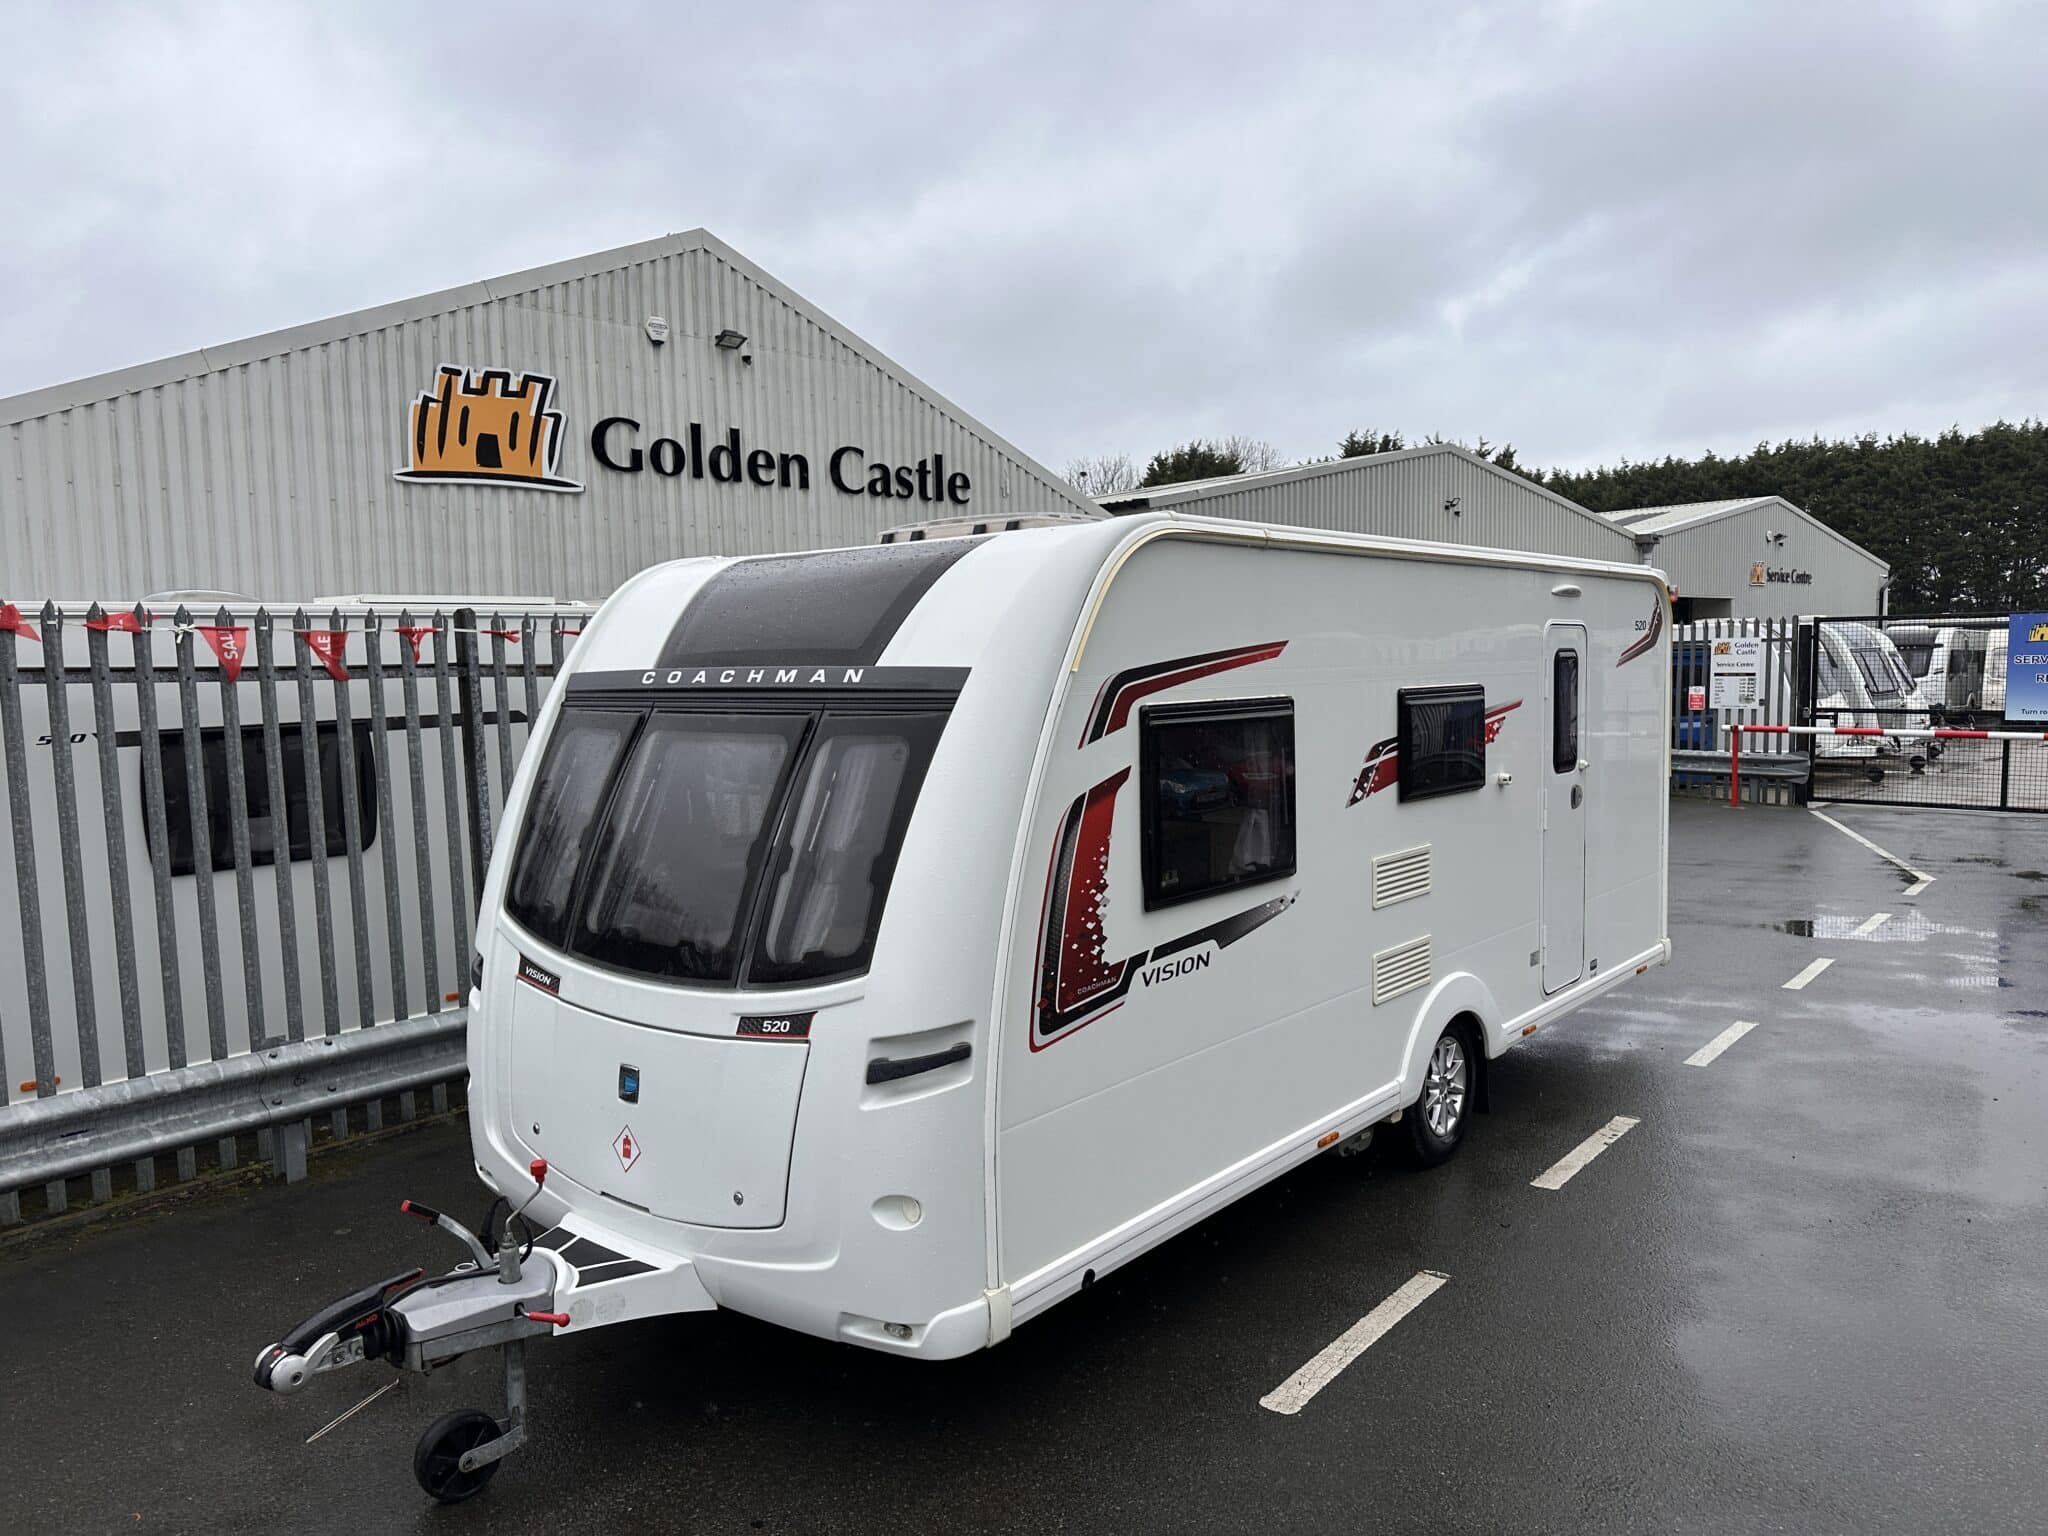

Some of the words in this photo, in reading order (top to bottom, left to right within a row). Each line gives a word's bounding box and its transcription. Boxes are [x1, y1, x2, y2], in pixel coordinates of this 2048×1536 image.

[591, 416, 809, 490] Golden
[830, 446, 971, 504] Castle
[1766, 567, 1790, 583] Service
[1791, 569, 1812, 585] Centre
[1635, 620, 1647, 631] 520
[218, 630, 239, 660] SAL
[1734, 641, 1759, 649] Golden
[1736, 648, 1757, 656] Castle
[642, 668, 864, 685] COACHMAN
[36, 733, 87, 746] 50
[525, 965, 552, 985] VISION
[1142, 951, 1210, 988] VISION
[1077, 976, 1117, 995] COACHMAN
[762, 1020, 790, 1033] 520
